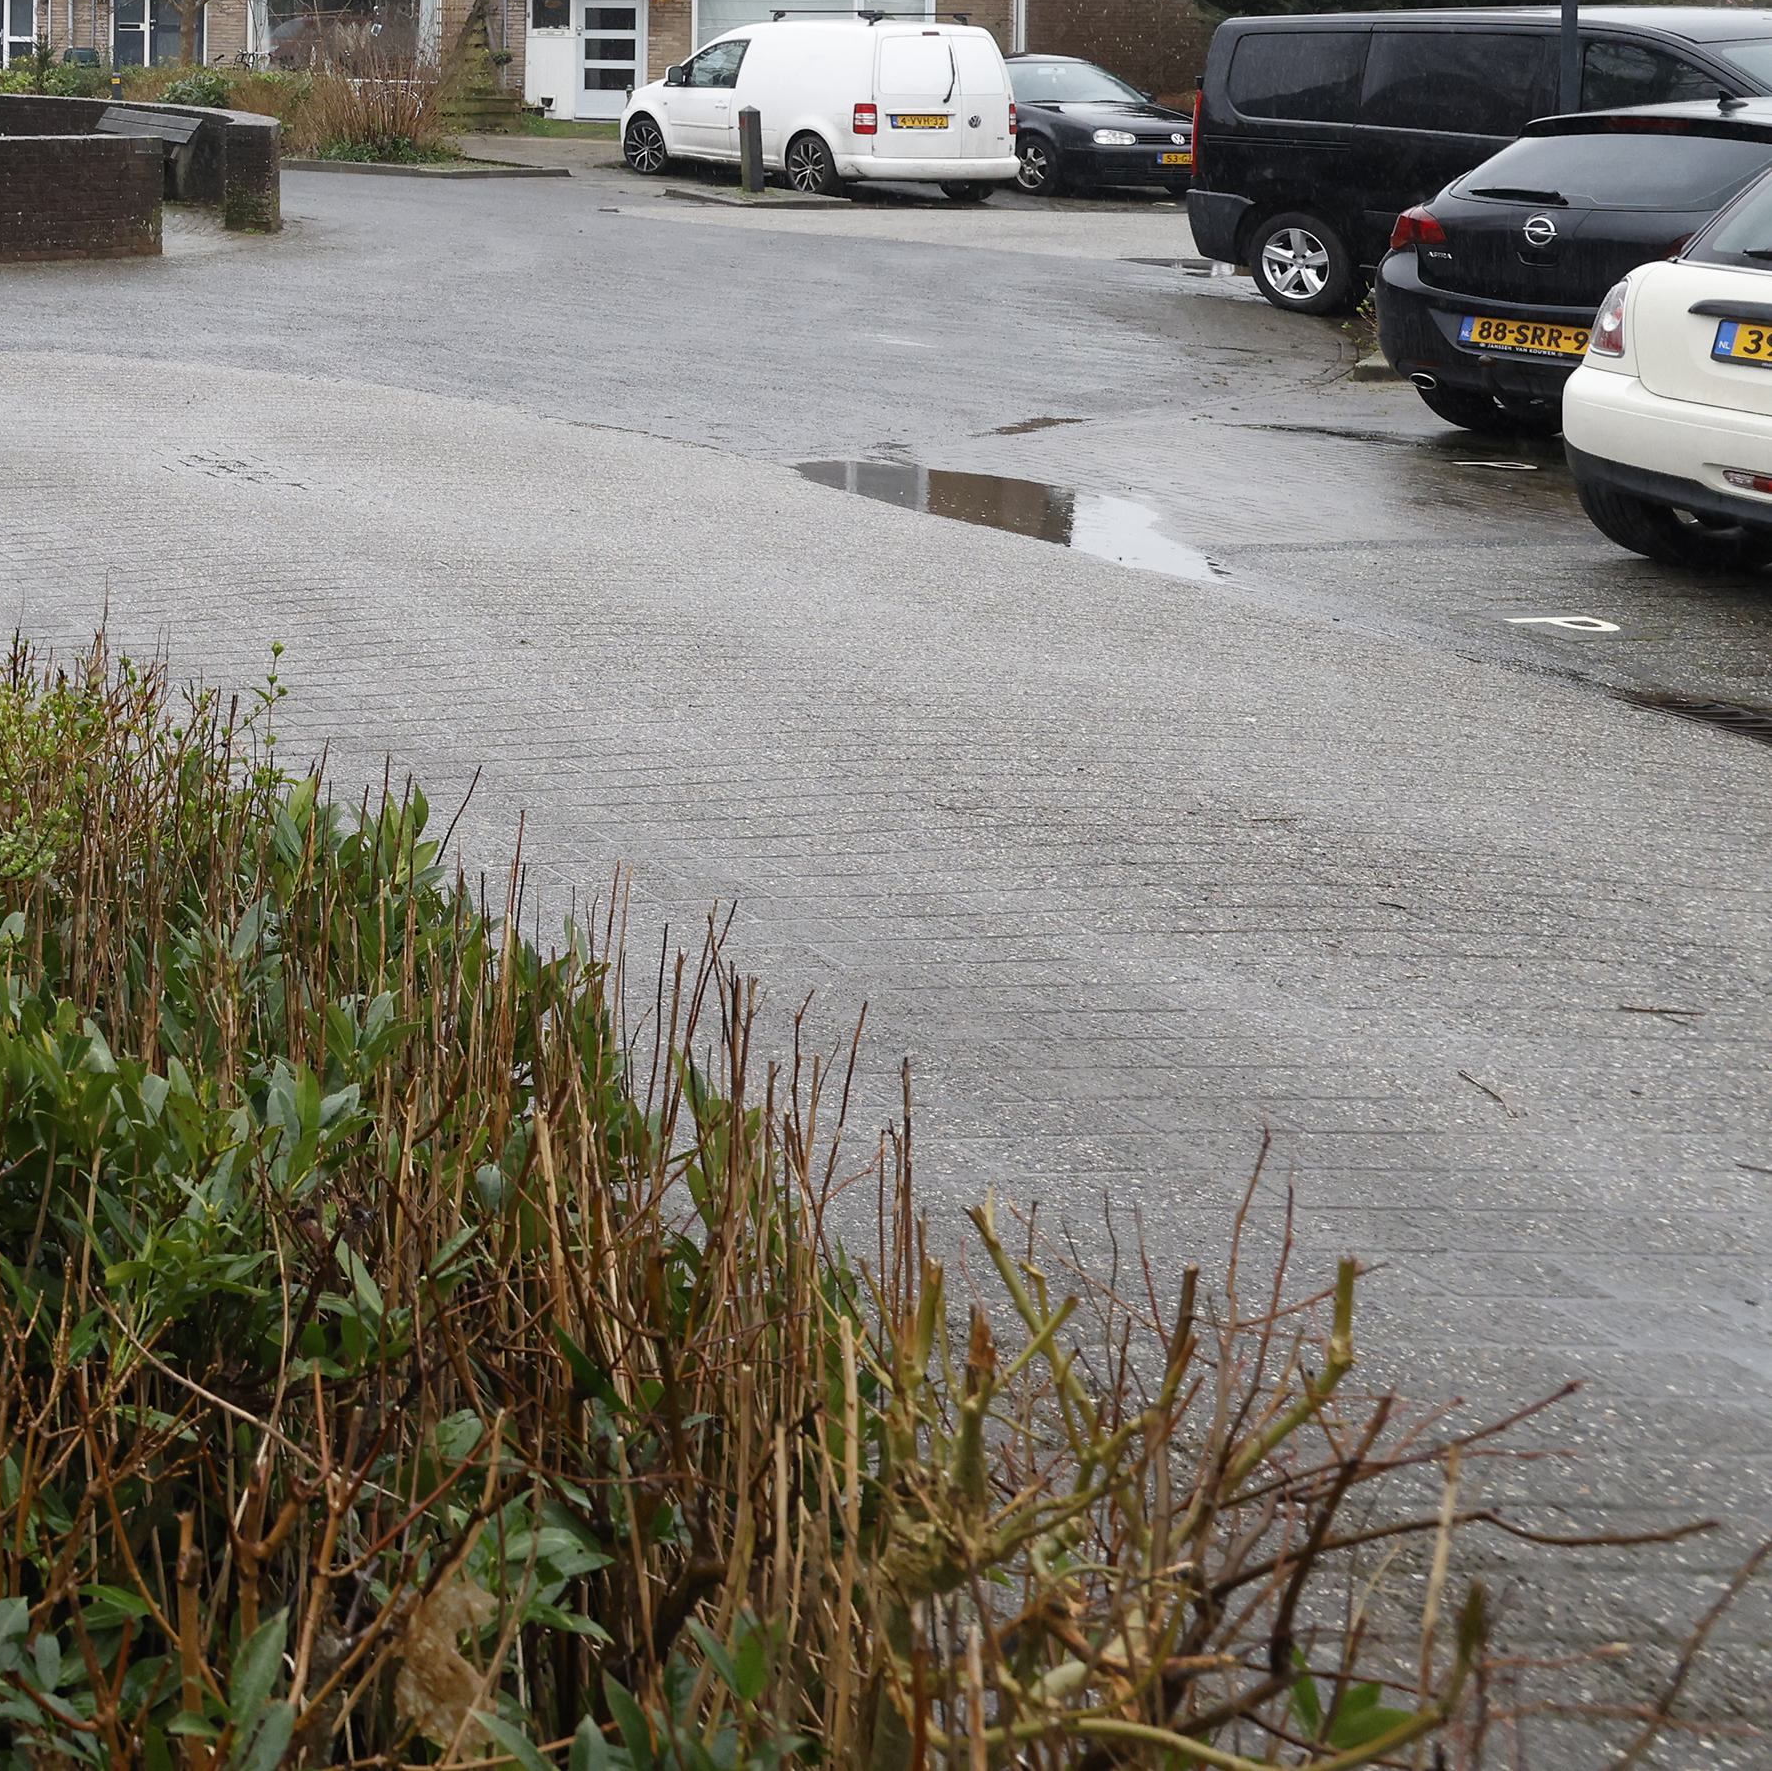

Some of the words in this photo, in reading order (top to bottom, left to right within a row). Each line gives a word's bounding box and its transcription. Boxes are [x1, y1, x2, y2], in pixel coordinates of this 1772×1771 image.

[900, 116, 945, 126] 4-VVH-32
[1478, 320, 1589, 351] 88-SRR-9
[1718, 340, 1731, 350] NL
